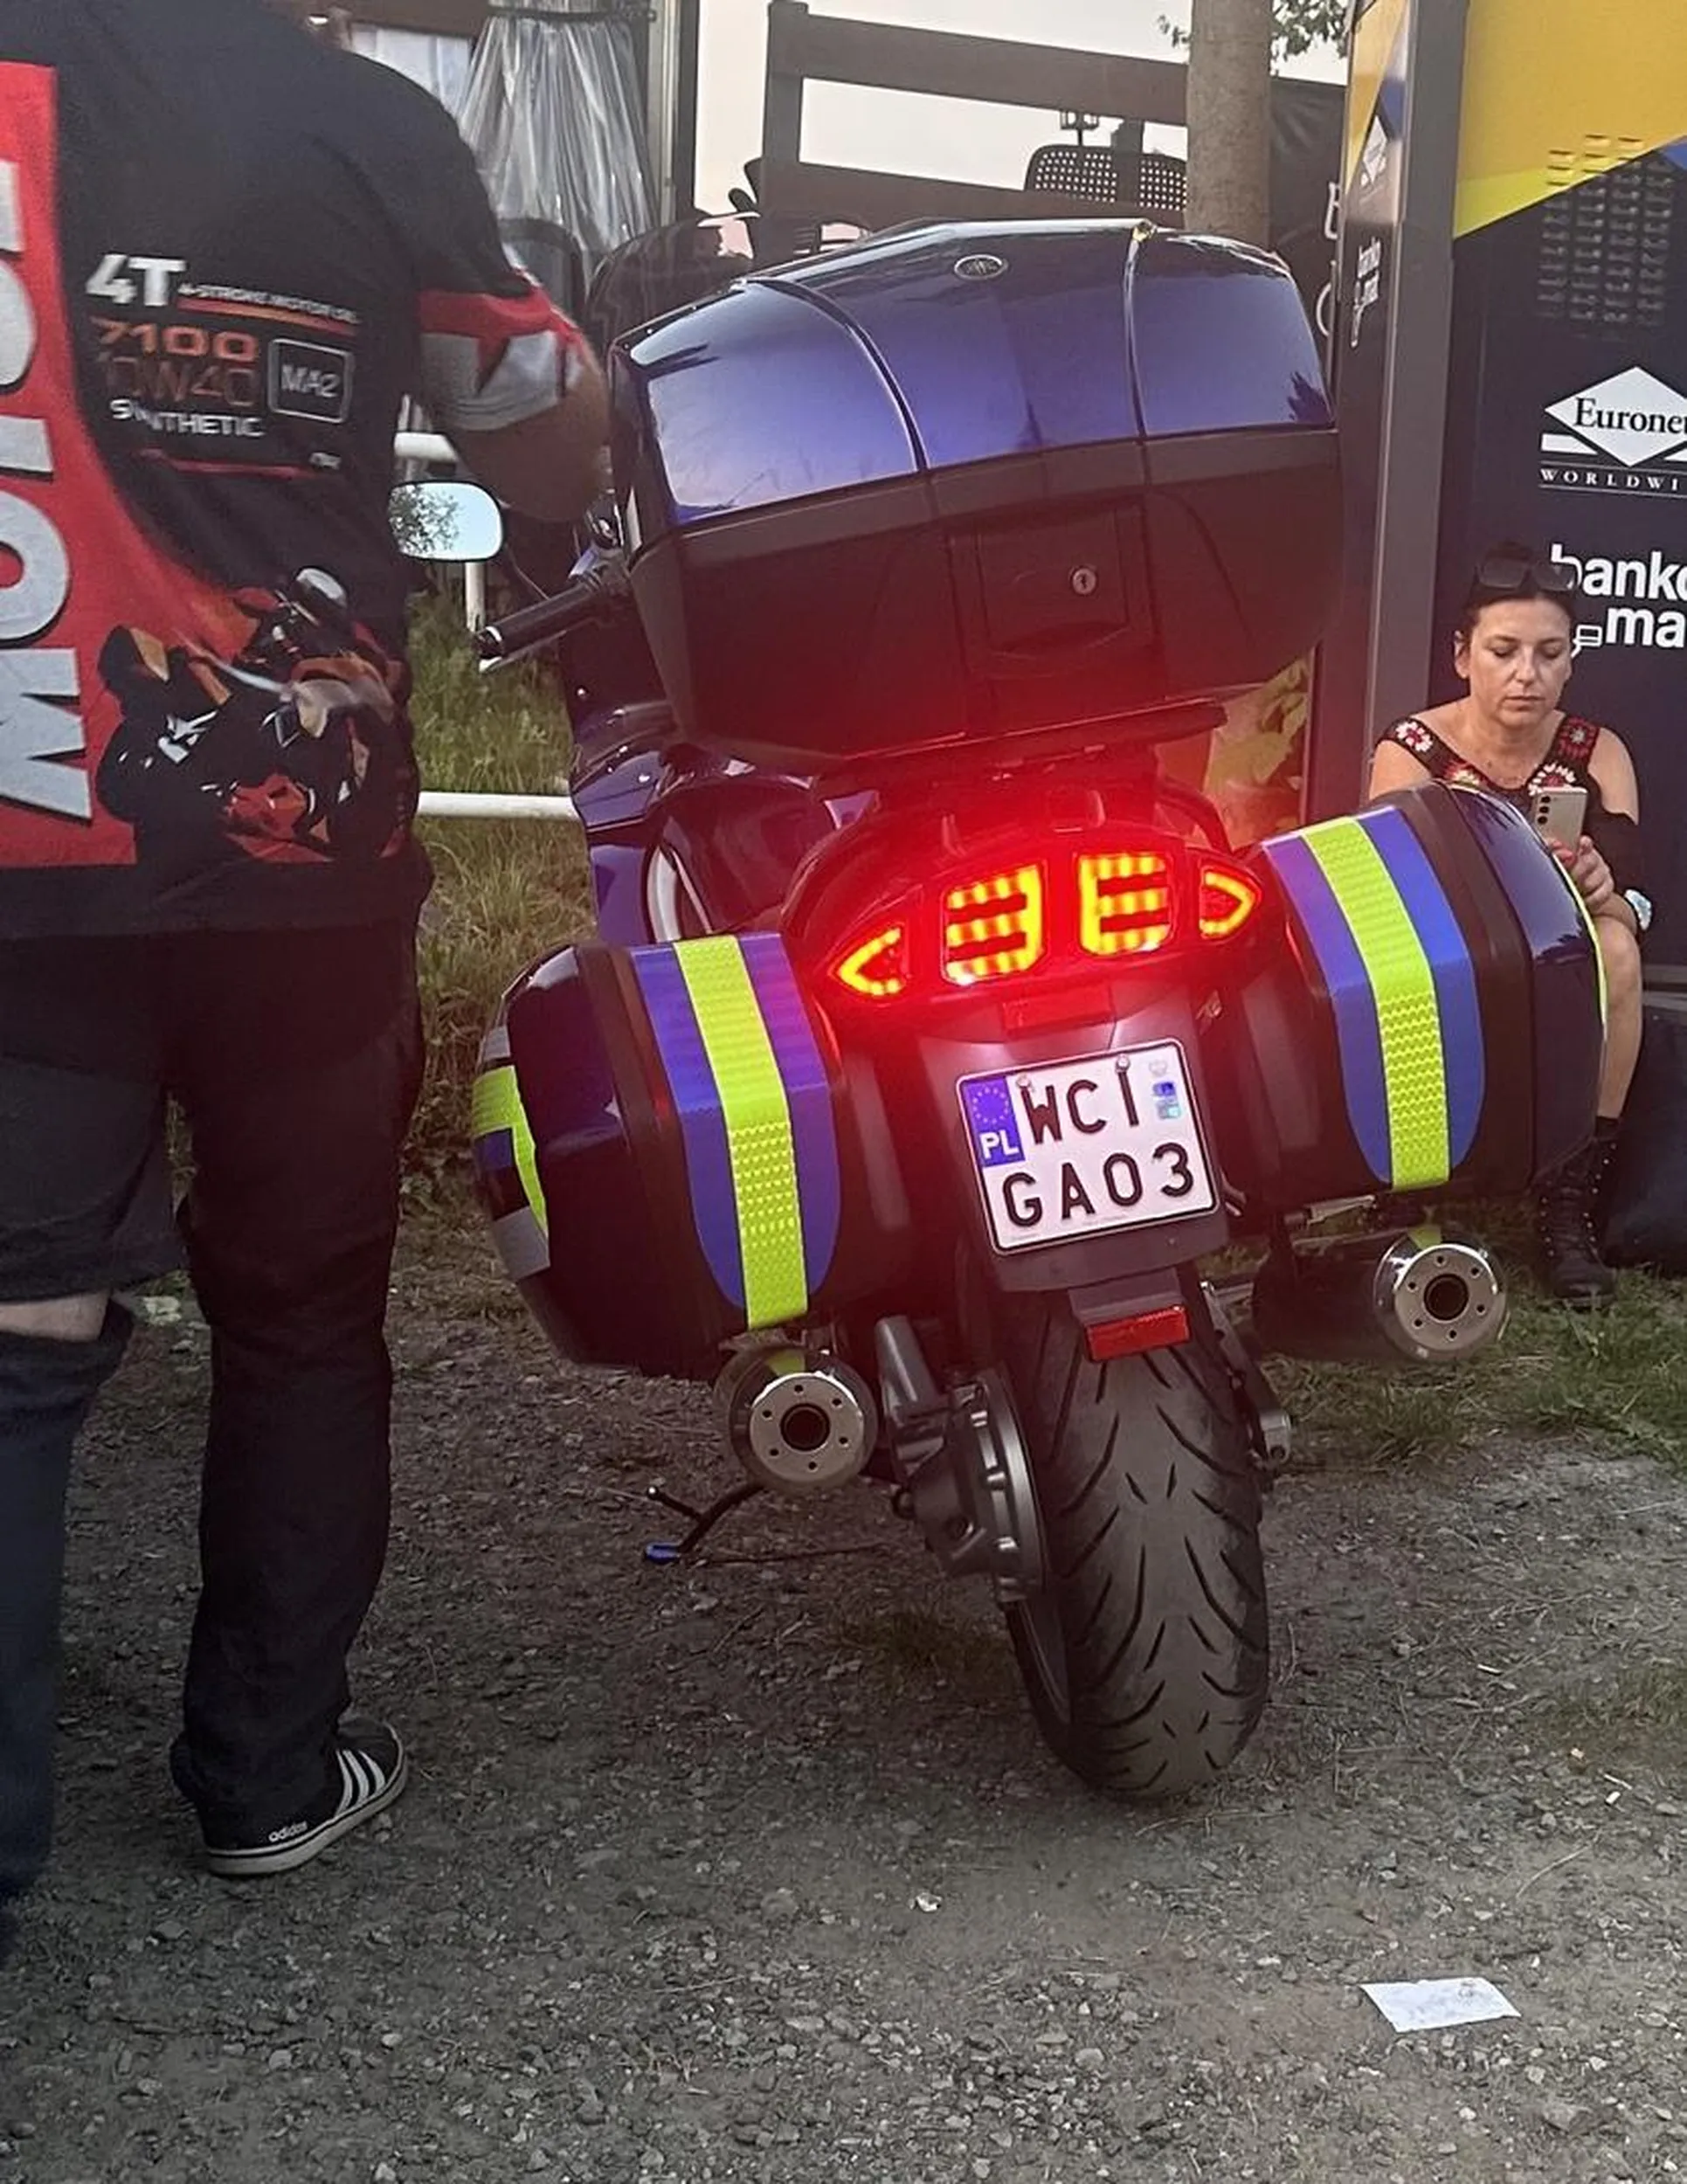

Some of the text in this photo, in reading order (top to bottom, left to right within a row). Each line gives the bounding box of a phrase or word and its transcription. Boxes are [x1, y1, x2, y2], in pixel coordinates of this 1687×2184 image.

[86, 252, 186, 307] 4T
[89, 315, 259, 363] 7100
[96, 351, 255, 408] 0W40
[1020, 1068, 1139, 1146] WCI
[979, 1131, 1020, 1160] PL
[1002, 1142, 1195, 1227] GA03
